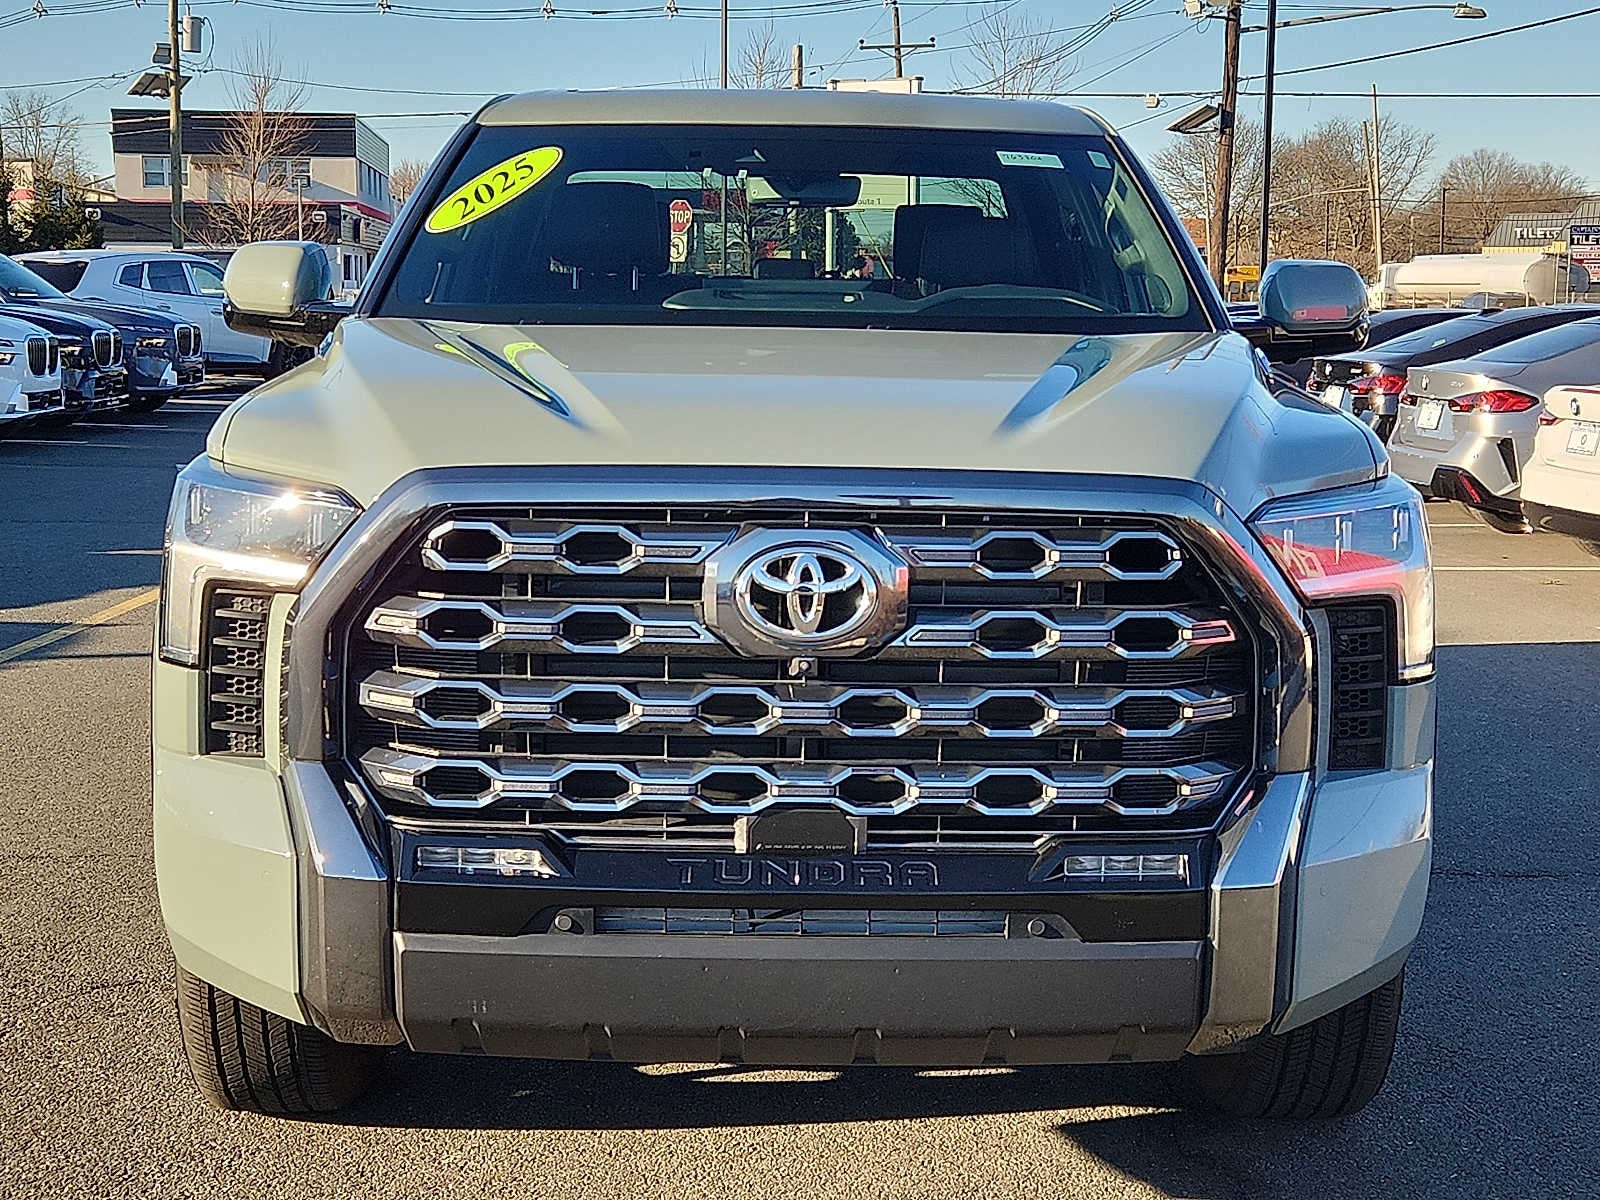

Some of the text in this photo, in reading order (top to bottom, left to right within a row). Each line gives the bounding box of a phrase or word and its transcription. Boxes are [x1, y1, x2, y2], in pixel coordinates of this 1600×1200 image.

[451, 157, 534, 221] 2025
[670, 210, 690, 224] STOP
[666, 858, 939, 887] TUNDRA
